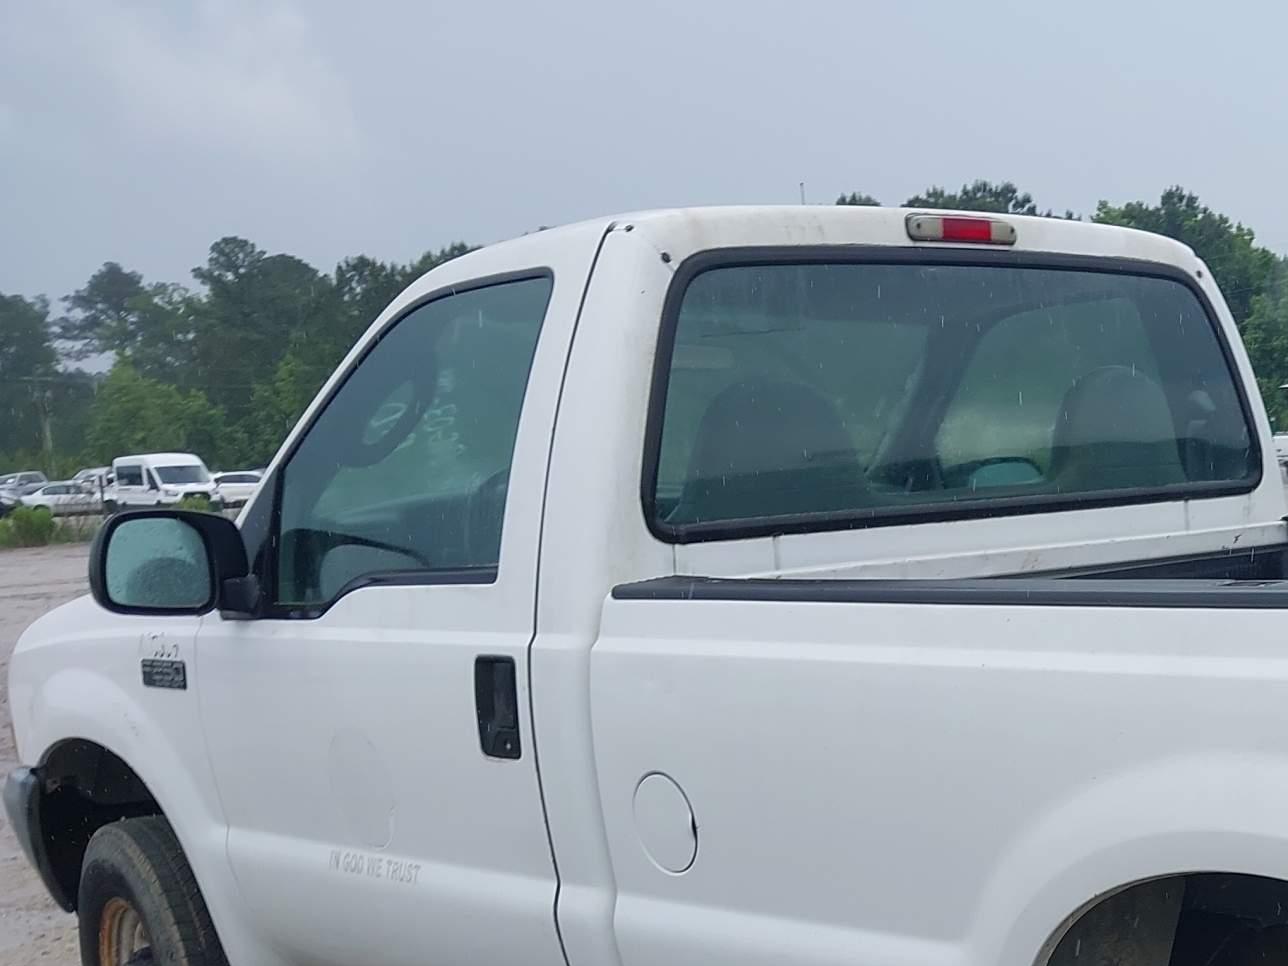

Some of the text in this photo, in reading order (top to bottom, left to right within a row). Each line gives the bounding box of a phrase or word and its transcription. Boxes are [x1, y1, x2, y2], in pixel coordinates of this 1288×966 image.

[328, 849, 422, 884] IN GOD WE TRUST
